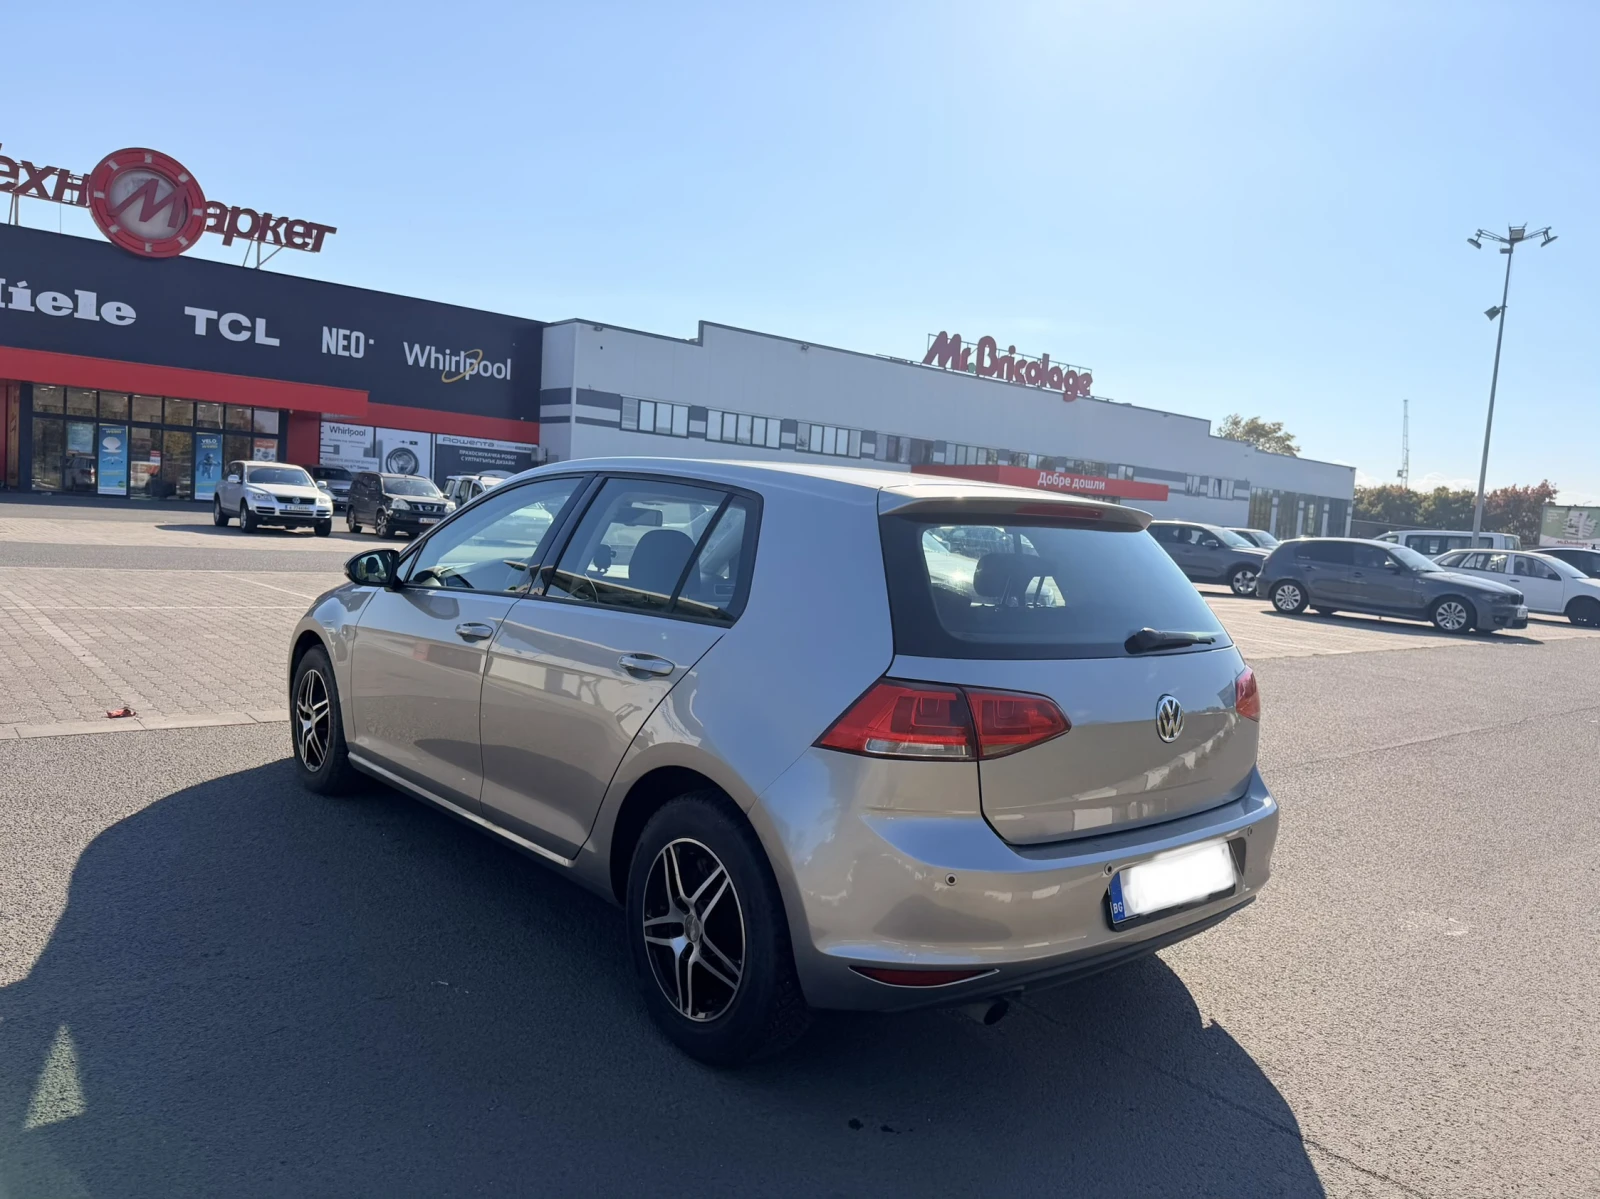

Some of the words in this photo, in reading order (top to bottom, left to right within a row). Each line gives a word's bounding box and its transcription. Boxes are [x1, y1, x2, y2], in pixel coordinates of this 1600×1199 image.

[0, 277, 137, 326] iele
[184, 306, 280, 347] TCL
[321, 326, 365, 359] NEO
[403, 341, 512, 381] Whirlpool
[329, 425, 366, 437] Whirlpool
[1038, 471, 1071, 488] Добре
[1072, 478, 1105, 490] дошли
[1112, 901, 1124, 914] BG
